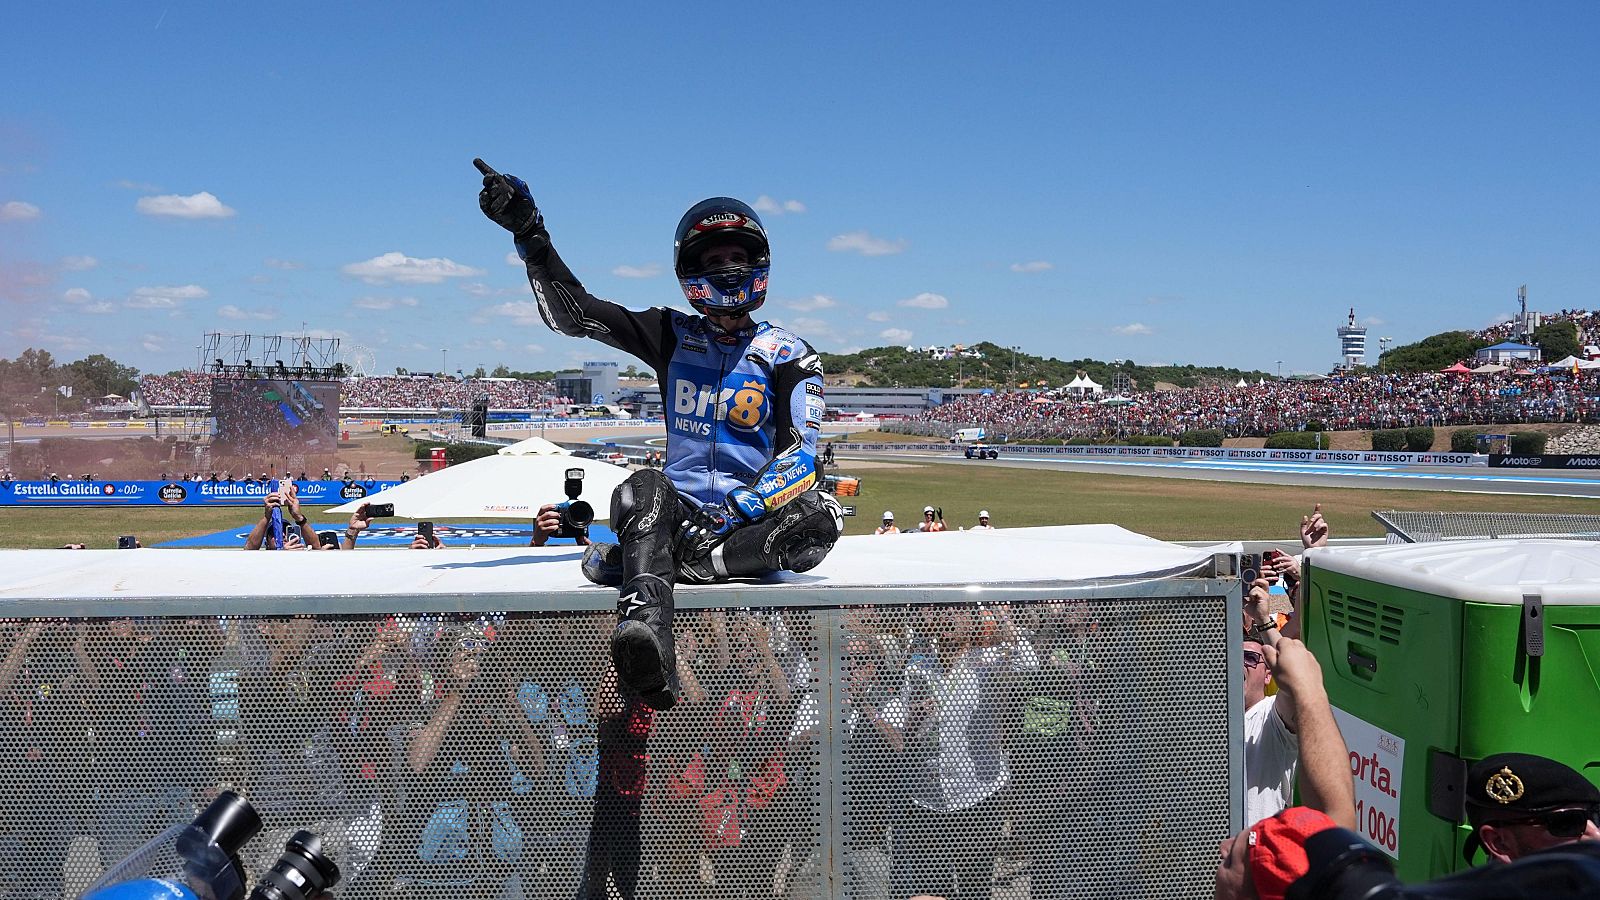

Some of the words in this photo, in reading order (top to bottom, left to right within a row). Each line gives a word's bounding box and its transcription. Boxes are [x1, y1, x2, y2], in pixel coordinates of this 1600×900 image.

[707, 213, 736, 223] SHOEI
[692, 285, 712, 299] Bull
[806, 383, 821, 393] BOLD
[674, 417, 712, 436] NEWS
[1162, 448, 1187, 456] TISSOT
[1200, 449, 1226, 457] TISSOT
[1239, 450, 1267, 458] TISSOT
[1281, 451, 1312, 460] TISSOT
[1328, 452, 1361, 461] TISSOT
[1378, 453, 1413, 463] TISSOT
[1432, 454, 1471, 464] TISSOT
[1566, 457, 1600, 466] Moto
[787, 464, 807, 482] NEWS
[13, 483, 58, 495] Estrella
[59, 483, 100, 495] Galicia
[201, 484, 243, 495] Estrella
[1350, 751, 1397, 798] orta.
[1355, 799, 1364, 832] 1
[1368, 806, 1397, 851] 006
